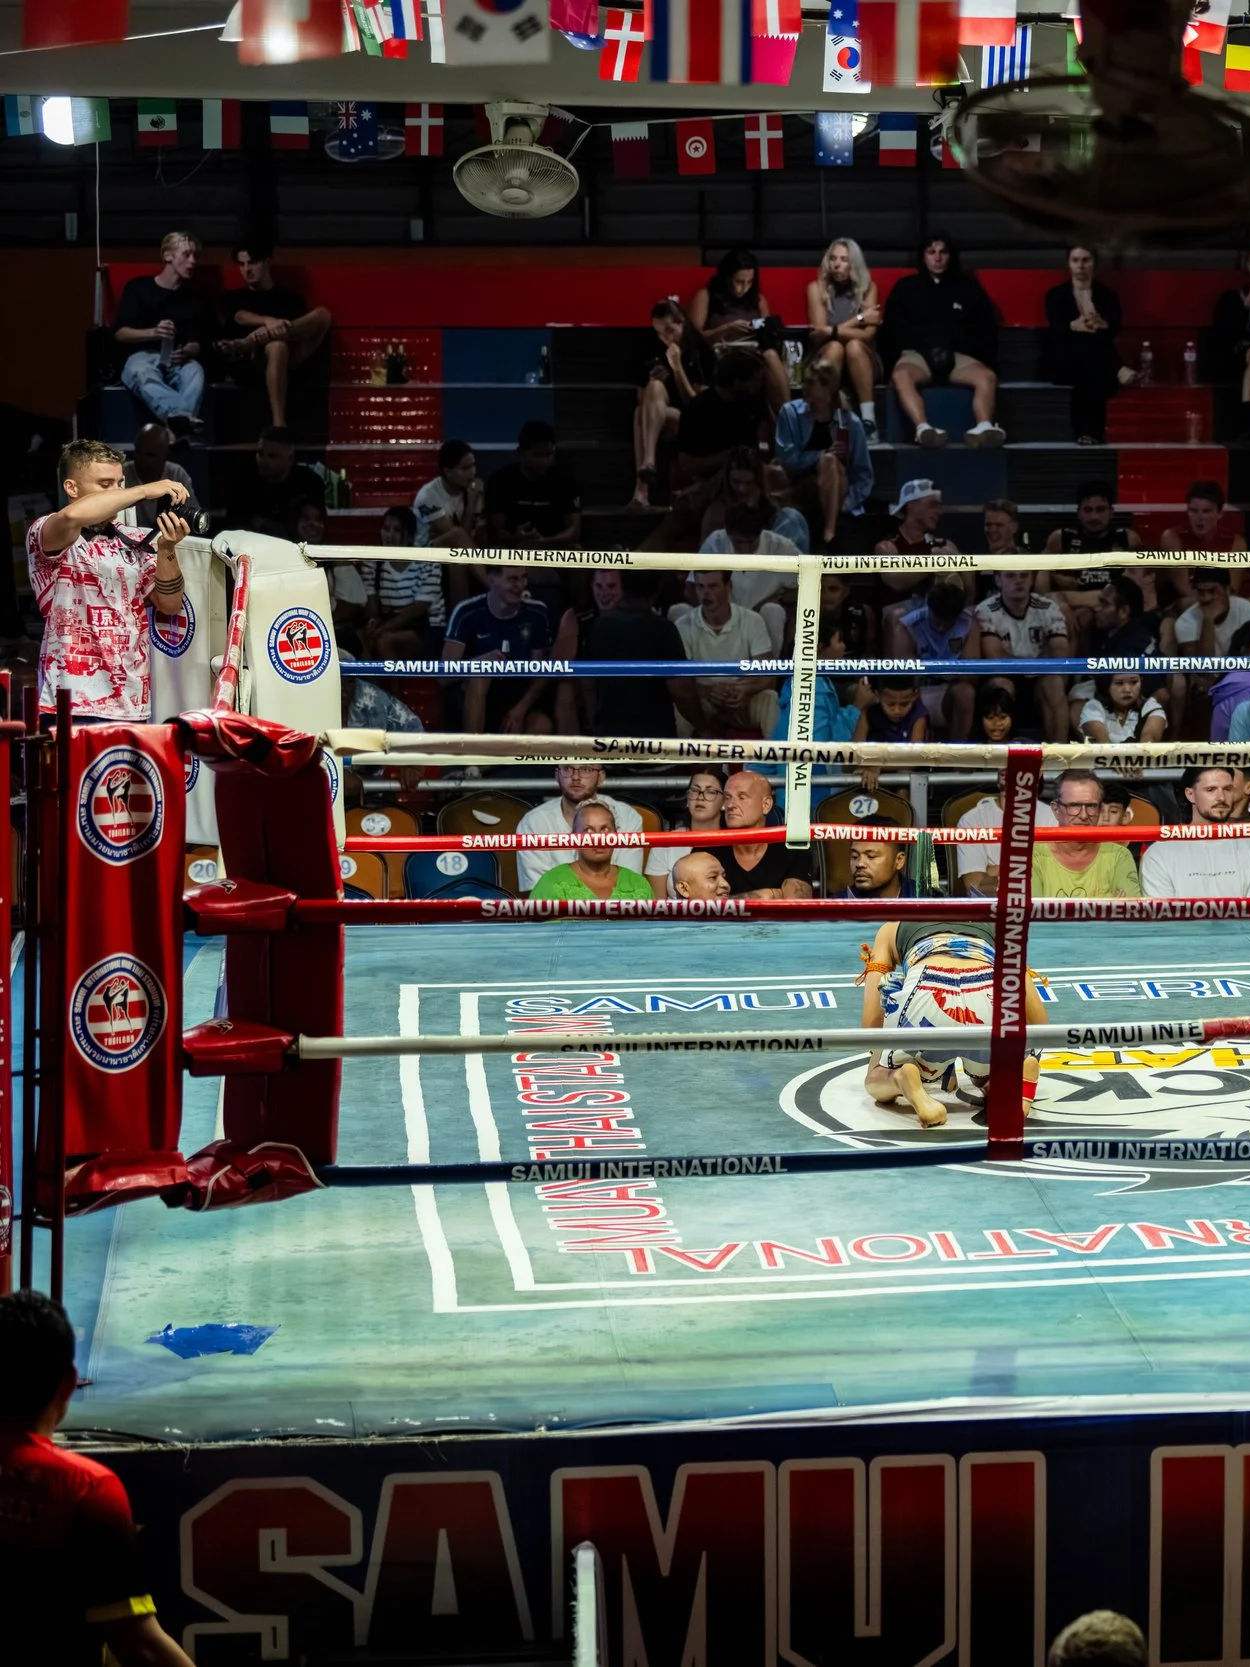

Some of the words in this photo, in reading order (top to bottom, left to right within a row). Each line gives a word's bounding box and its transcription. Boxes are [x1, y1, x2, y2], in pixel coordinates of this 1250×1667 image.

[449, 547, 502, 559] SAMUI
[508, 547, 634, 565] INTERNATIONAL
[855, 555, 978, 569] INTERNATIONAL
[802, 608, 815, 661] SAMUI
[290, 659, 315, 669] THAILAND
[384, 659, 438, 673] SAMUI
[444, 659, 574, 673] INTERNATIONAL
[816, 658, 925, 671] TERNATIONAL
[1086, 656, 1139, 670] SAMUI
[794, 667, 814, 791] INTERNATNAL
[853, 796, 874, 814] 27
[1010, 771, 1034, 849] SAMUI
[462, 832, 516, 847] SAMUI
[521, 831, 650, 847] INTERNATIONAL
[813, 825, 867, 840] SAMUI
[872, 827, 998, 841] INTERATIONAL
[1160, 825, 1213, 839] SAMUI
[193, 862, 217, 878] 20
[440, 855, 462, 872] 18
[481, 899, 560, 917] SAMUI
[567, 899, 751, 917] INTERNATIONAL
[1000, 855, 1028, 1039] INTERNATIONAL
[503, 988, 838, 1016] SAMUI
[104, 1034, 135, 1046] THAILAND
[1067, 1026, 1144, 1045] SAMUI
[1032, 1141, 1112, 1160] SAMUI
[511, 1162, 592, 1182] SAMUI
[600, 1156, 788, 1180] INTERNATIONAL
[179, 1449, 1047, 1667] SAMUI
